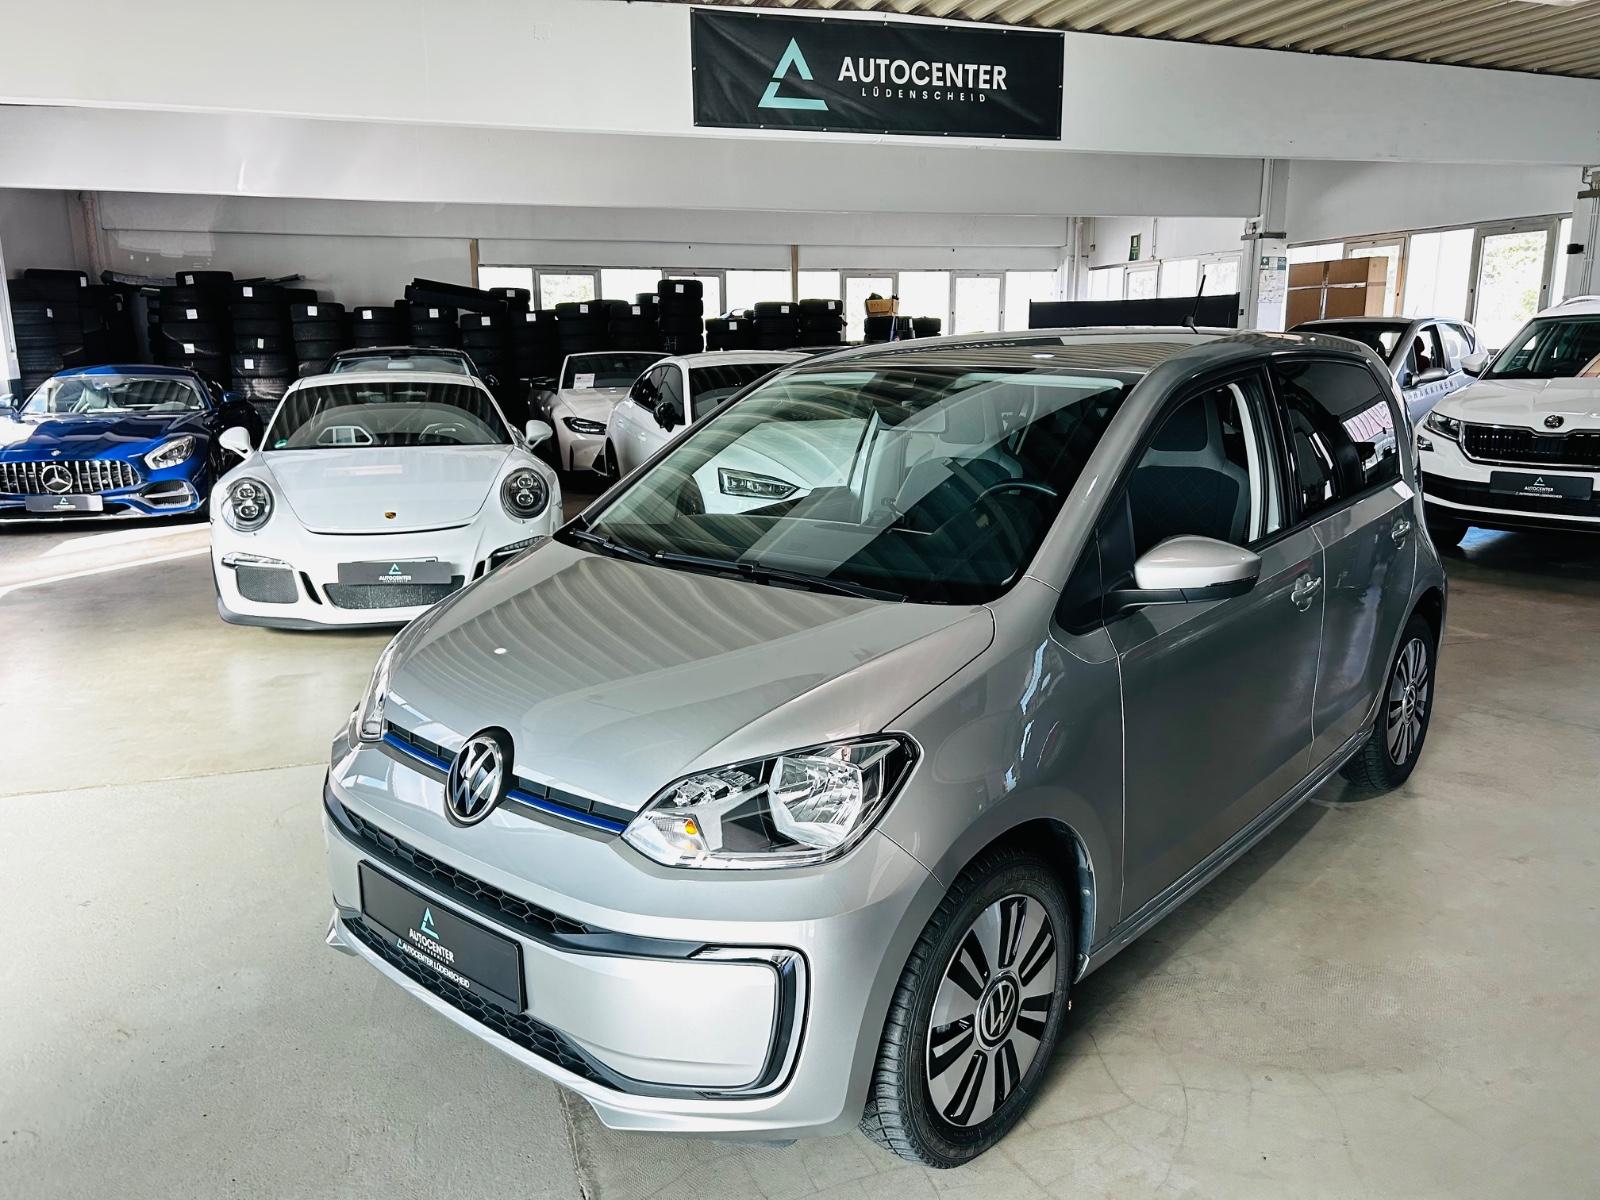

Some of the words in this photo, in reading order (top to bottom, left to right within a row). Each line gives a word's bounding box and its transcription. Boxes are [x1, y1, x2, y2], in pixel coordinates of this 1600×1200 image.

[838, 56, 1007, 90] AUTOCENTER
[861, 86, 986, 102] LÜDENSCHEID
[402, 943, 434, 968] AUTOCENTER
[409, 928, 455, 963] AUTOCENTER
